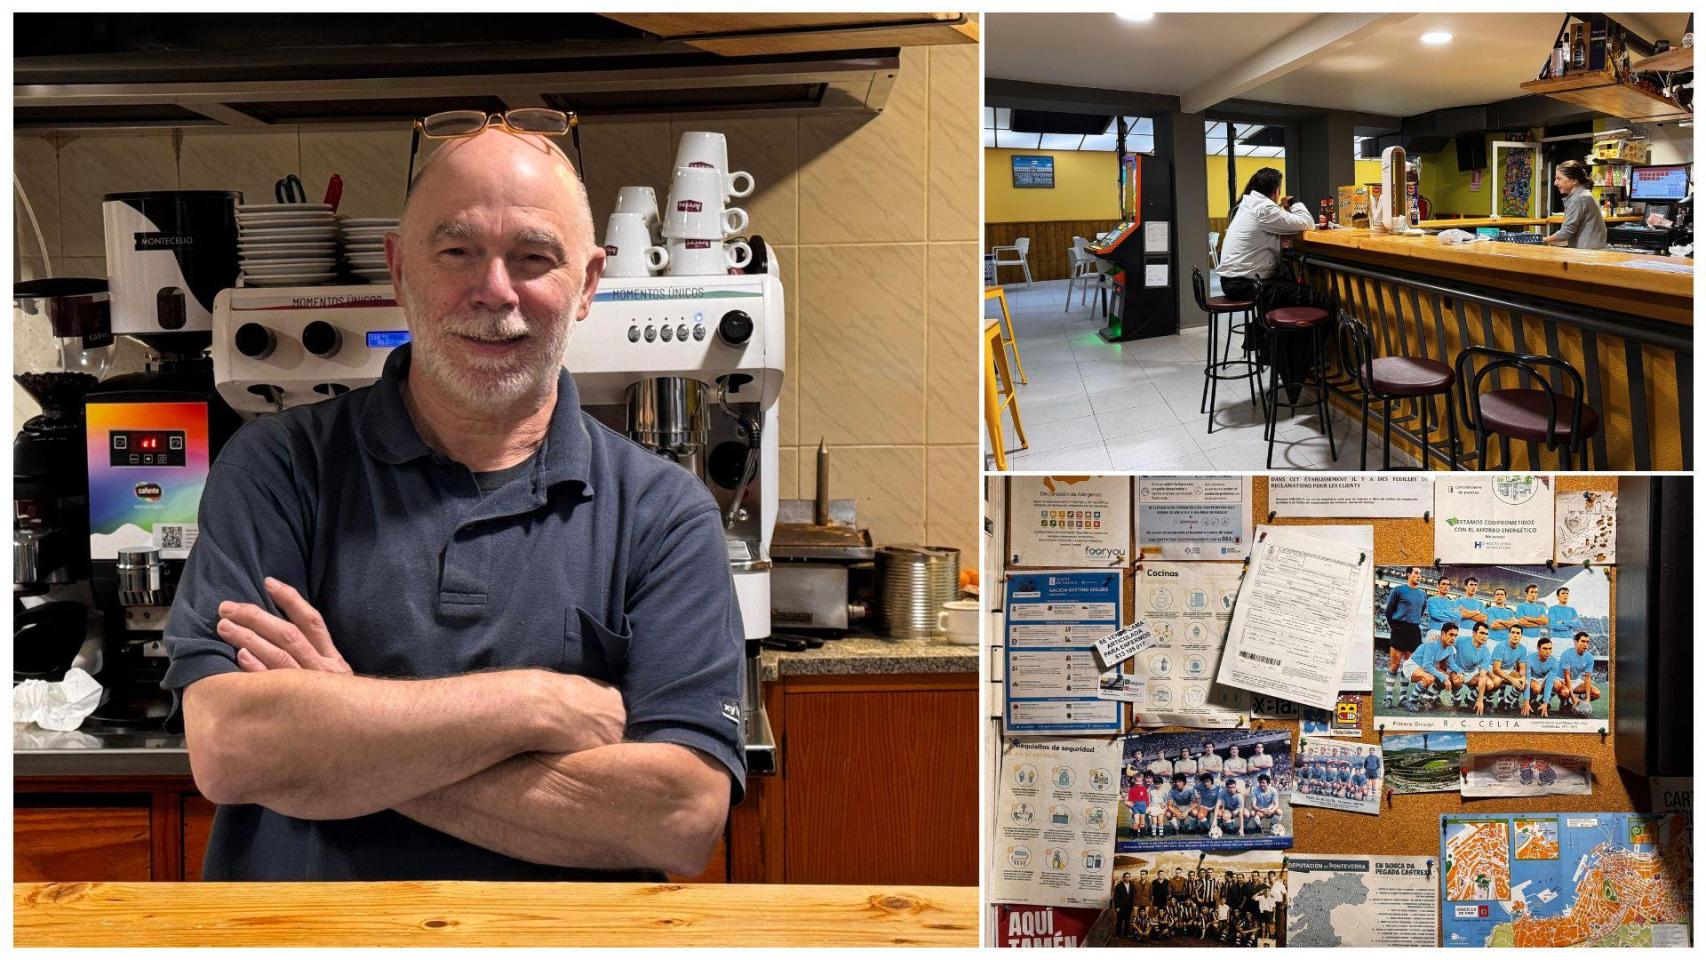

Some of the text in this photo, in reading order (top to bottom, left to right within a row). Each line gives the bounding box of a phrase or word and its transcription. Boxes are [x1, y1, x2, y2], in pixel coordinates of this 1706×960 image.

[612, 286, 704, 300] MOMENTOS ÚNICOS
[293, 297, 344, 307] MOMENTOS
[1147, 569, 1179, 577] Cocinas
[1104, 646, 1120, 657] PARA
[1479, 720, 1520, 728] CELTA
[1664, 791, 1694, 808] CAR
[1008, 907, 1054, 937] AQUÍ
